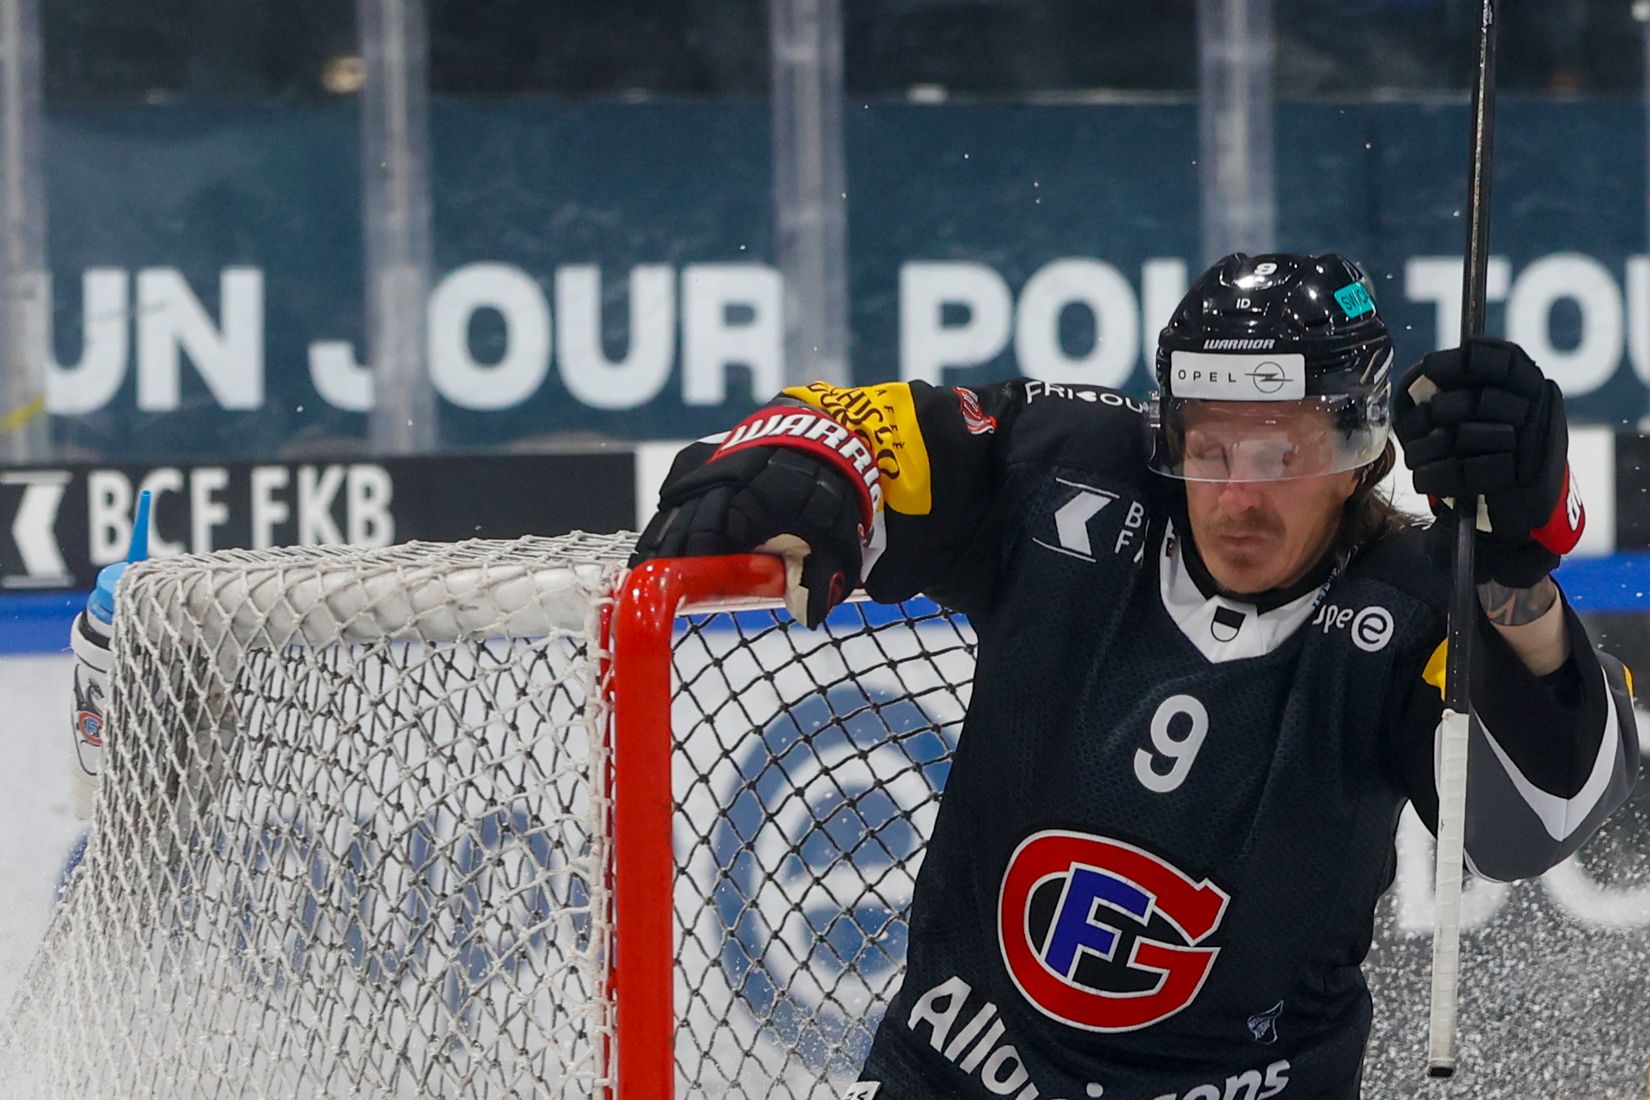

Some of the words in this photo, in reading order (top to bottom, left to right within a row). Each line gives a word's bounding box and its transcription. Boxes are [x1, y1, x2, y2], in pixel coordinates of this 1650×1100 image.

[22, 264, 266, 416] UN
[1203, 339, 1275, 350] WARRIOR
[1178, 369, 1237, 384] OPEL
[1133, 694, 1210, 793] 9
